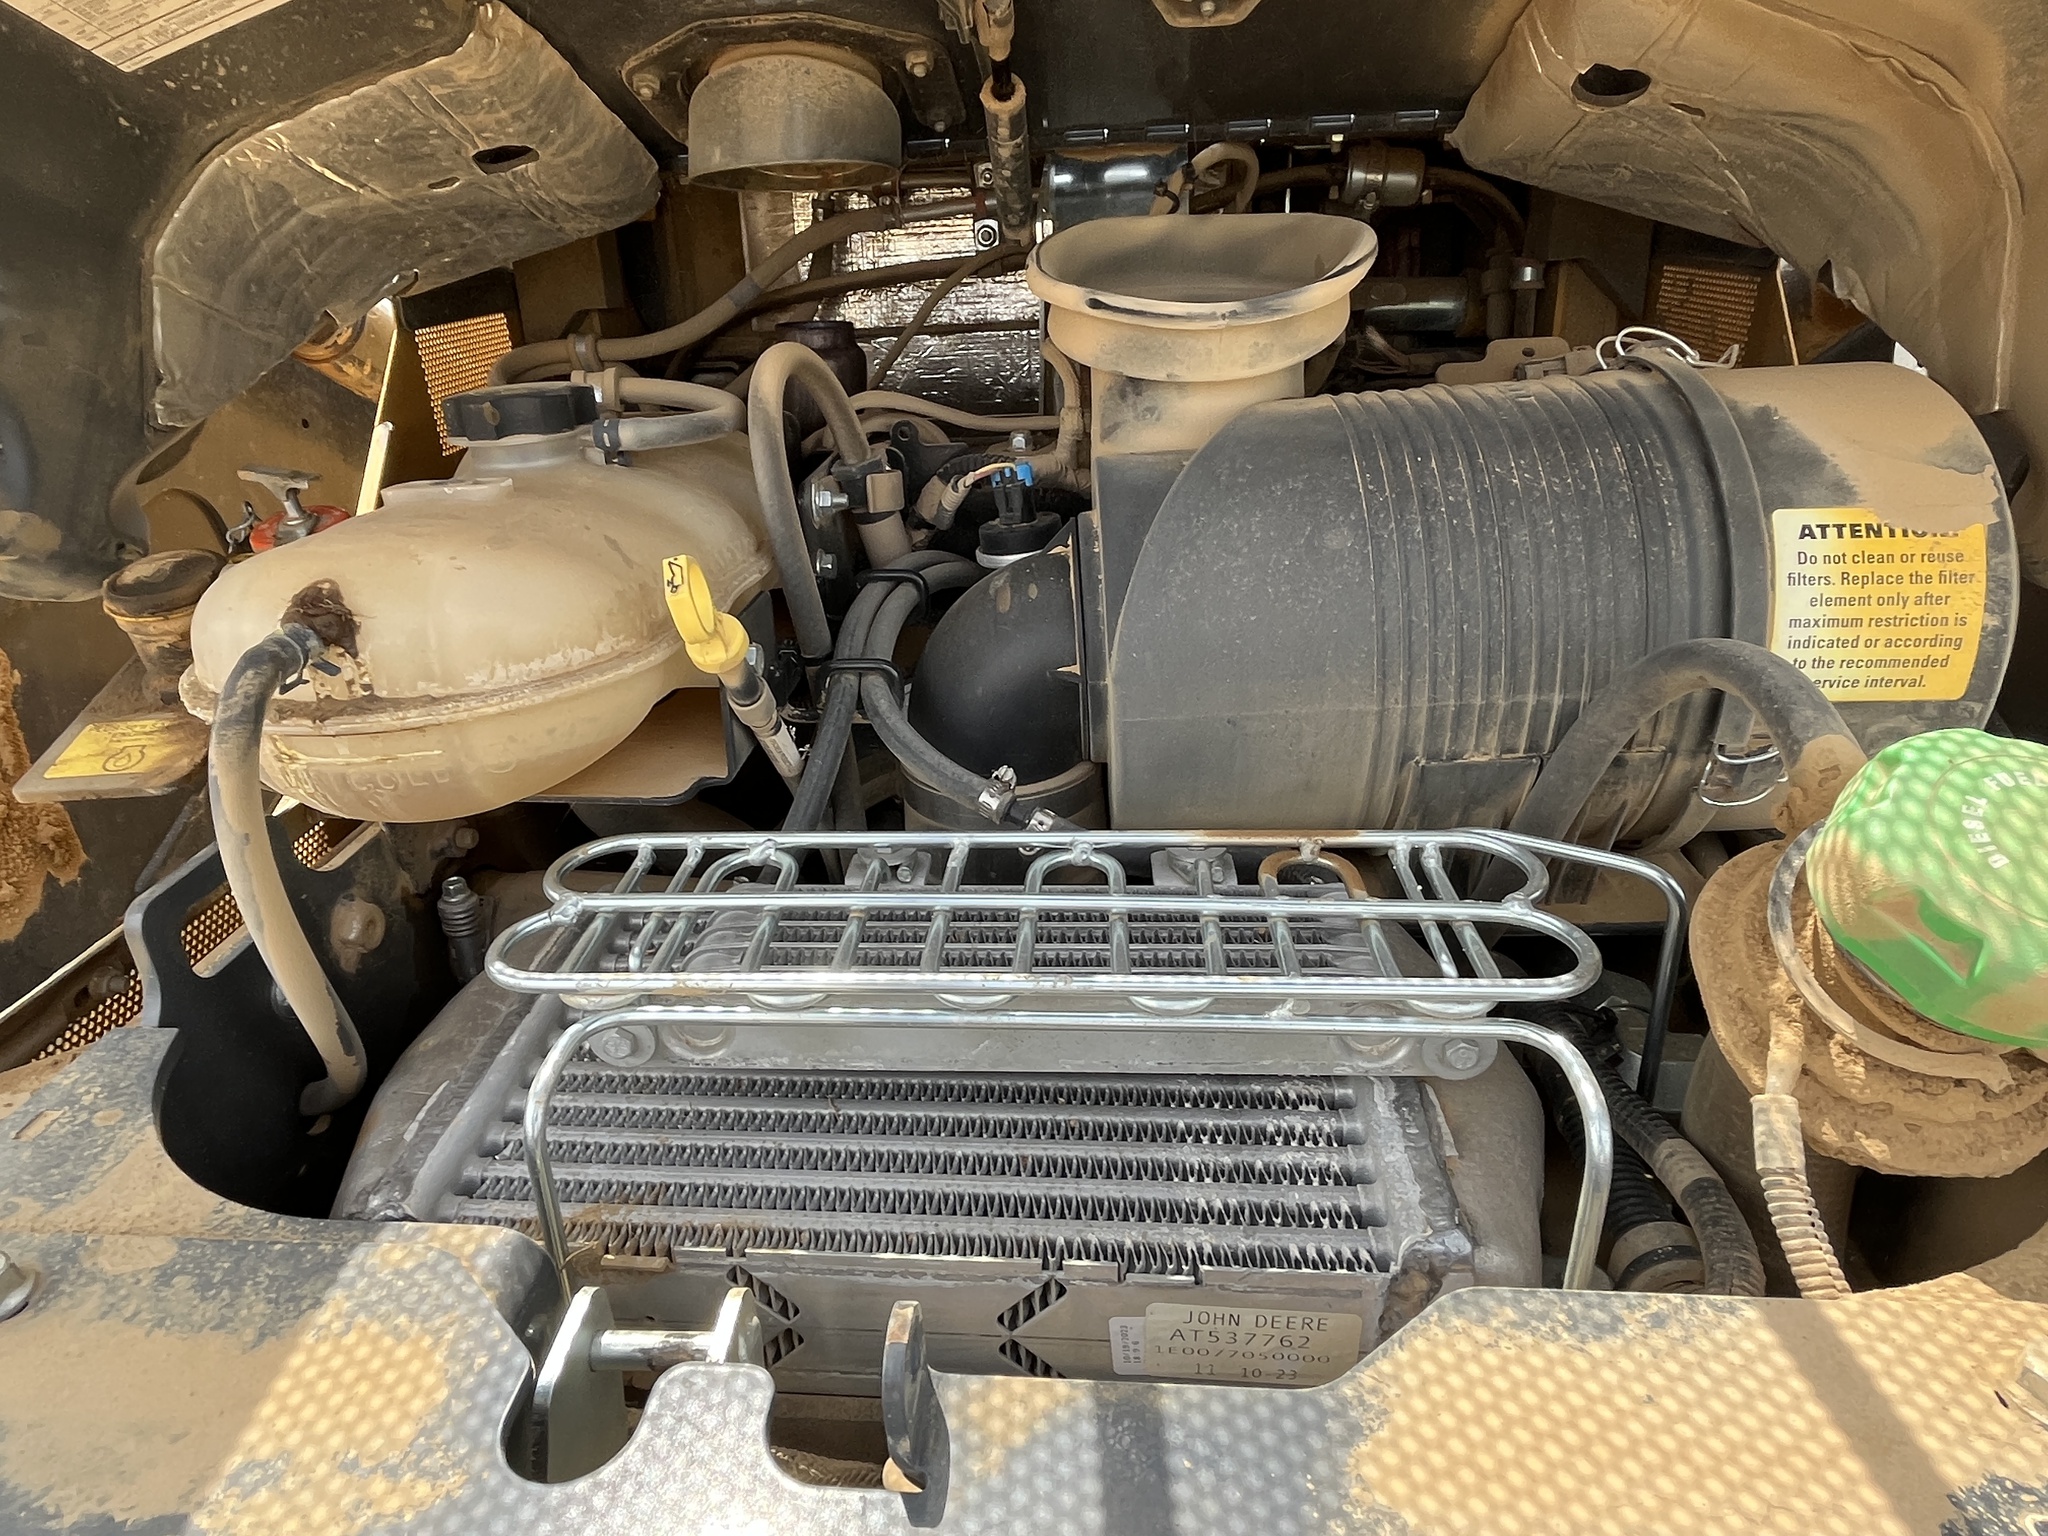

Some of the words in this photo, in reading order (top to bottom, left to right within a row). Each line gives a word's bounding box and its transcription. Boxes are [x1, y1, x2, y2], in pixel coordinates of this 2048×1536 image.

[1798, 522, 1959, 540] ATTENTIO
[1797, 551, 1818, 566] Do
[1822, 551, 1848, 565] not
[1851, 550, 1896, 565] clean
[1900, 552, 1917, 564] or
[1920, 552, 1965, 564] reuse
[1786, 571, 1836, 586] filters.
[1840, 571, 1905, 589] Replace
[1909, 571, 1934, 585] the
[1938, 570, 1976, 585] filter
[1809, 593, 1873, 608] element
[1876, 592, 1911, 612] only
[1914, 592, 1952, 607] after
[1788, 614, 1864, 629] maximum
[1868, 613, 1950, 628] restriction
[1953, 612, 1968, 627] is
[1787, 635, 1860, 650] indicated
[1863, 637, 1880, 649] or
[1884, 635, 1964, 651] according
[1793, 657, 1807, 669] to
[1811, 655, 1836, 669] the
[1839, 655, 1951, 669] recommended
[1812, 675, 1860, 689] ervice
[1863, 675, 1928, 689] interval.
[1961, 794, 2011, 869] DIESEL
[1183, 1310, 1241, 1328] JOHN
[1254, 1313, 1330, 1333] DEERE
[1169, 1328, 1312, 1350] AT537762
[1240, 1366, 1299, 1381] 10-23
